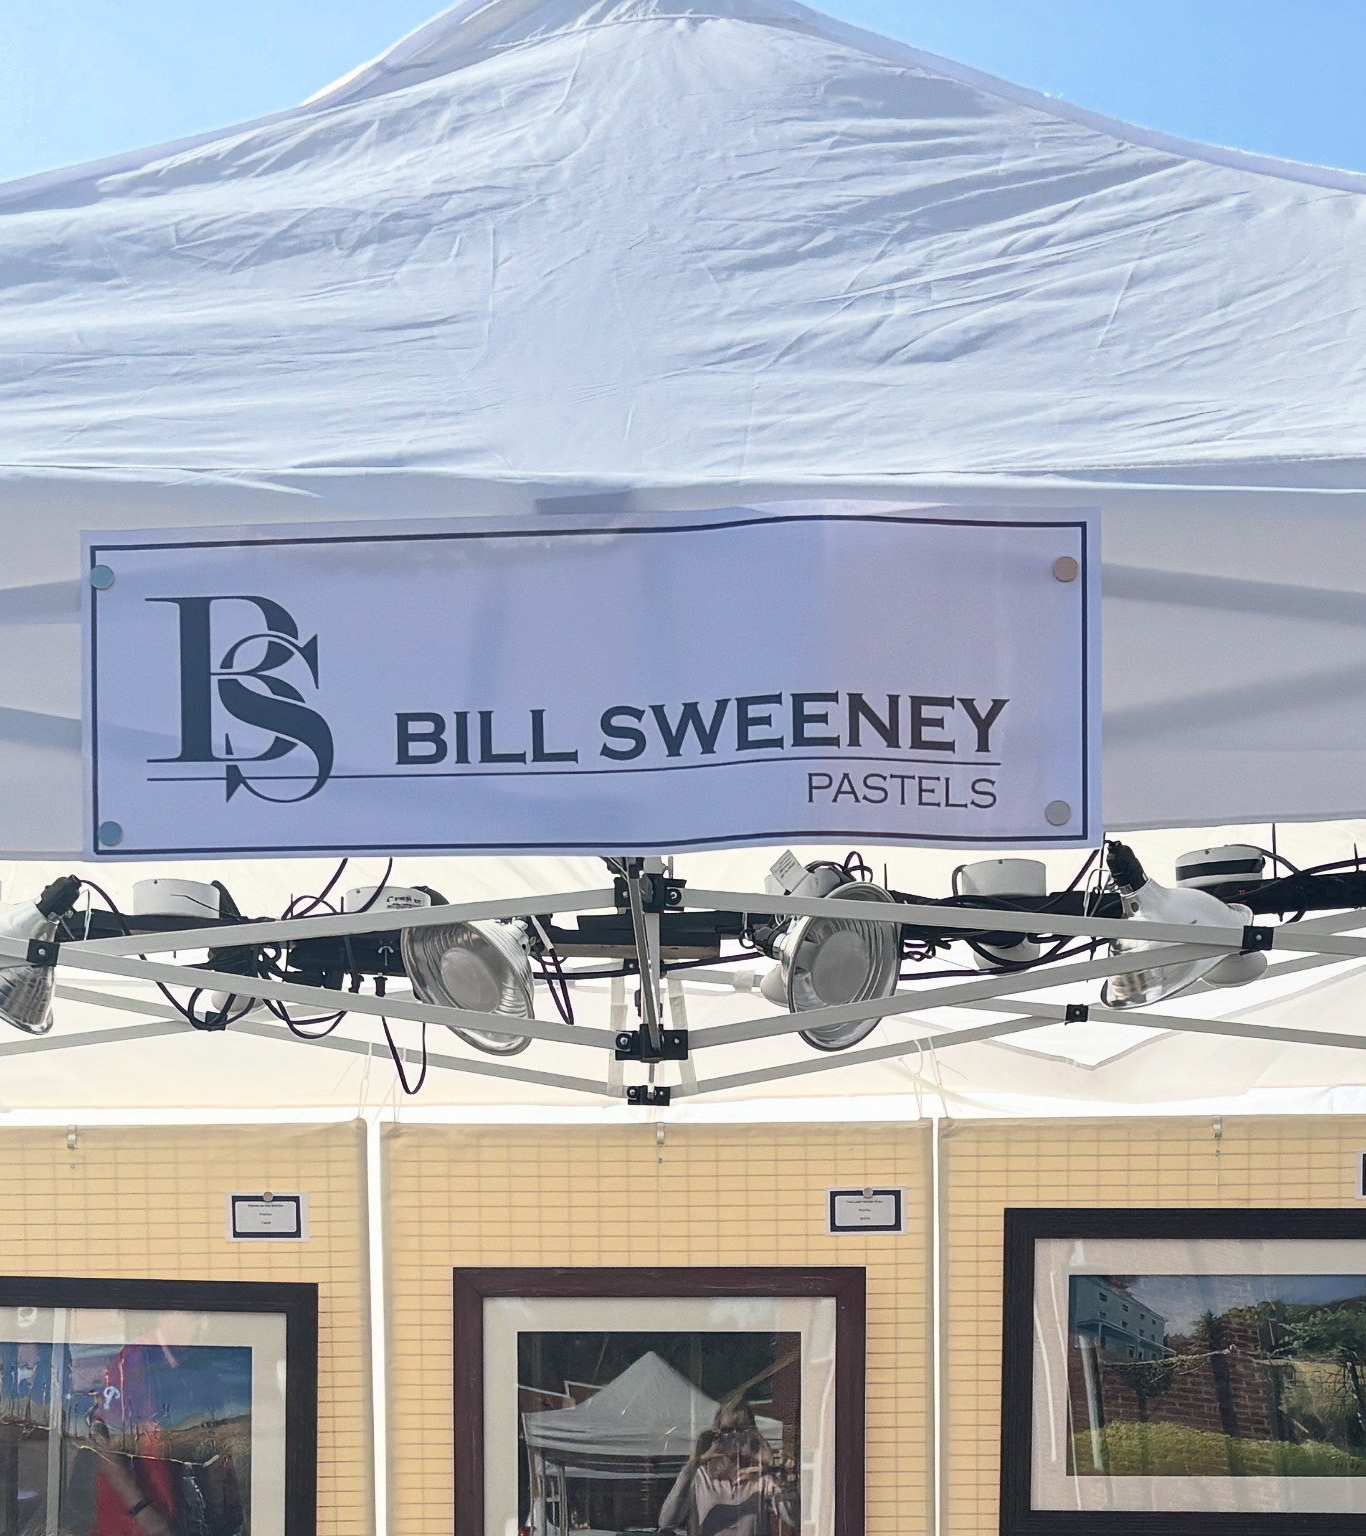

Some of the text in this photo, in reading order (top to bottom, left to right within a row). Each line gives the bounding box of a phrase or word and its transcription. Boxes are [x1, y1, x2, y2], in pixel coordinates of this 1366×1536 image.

[395, 690, 1010, 765] BILL SWEENEY
[807, 772, 997, 809] PASTELS
